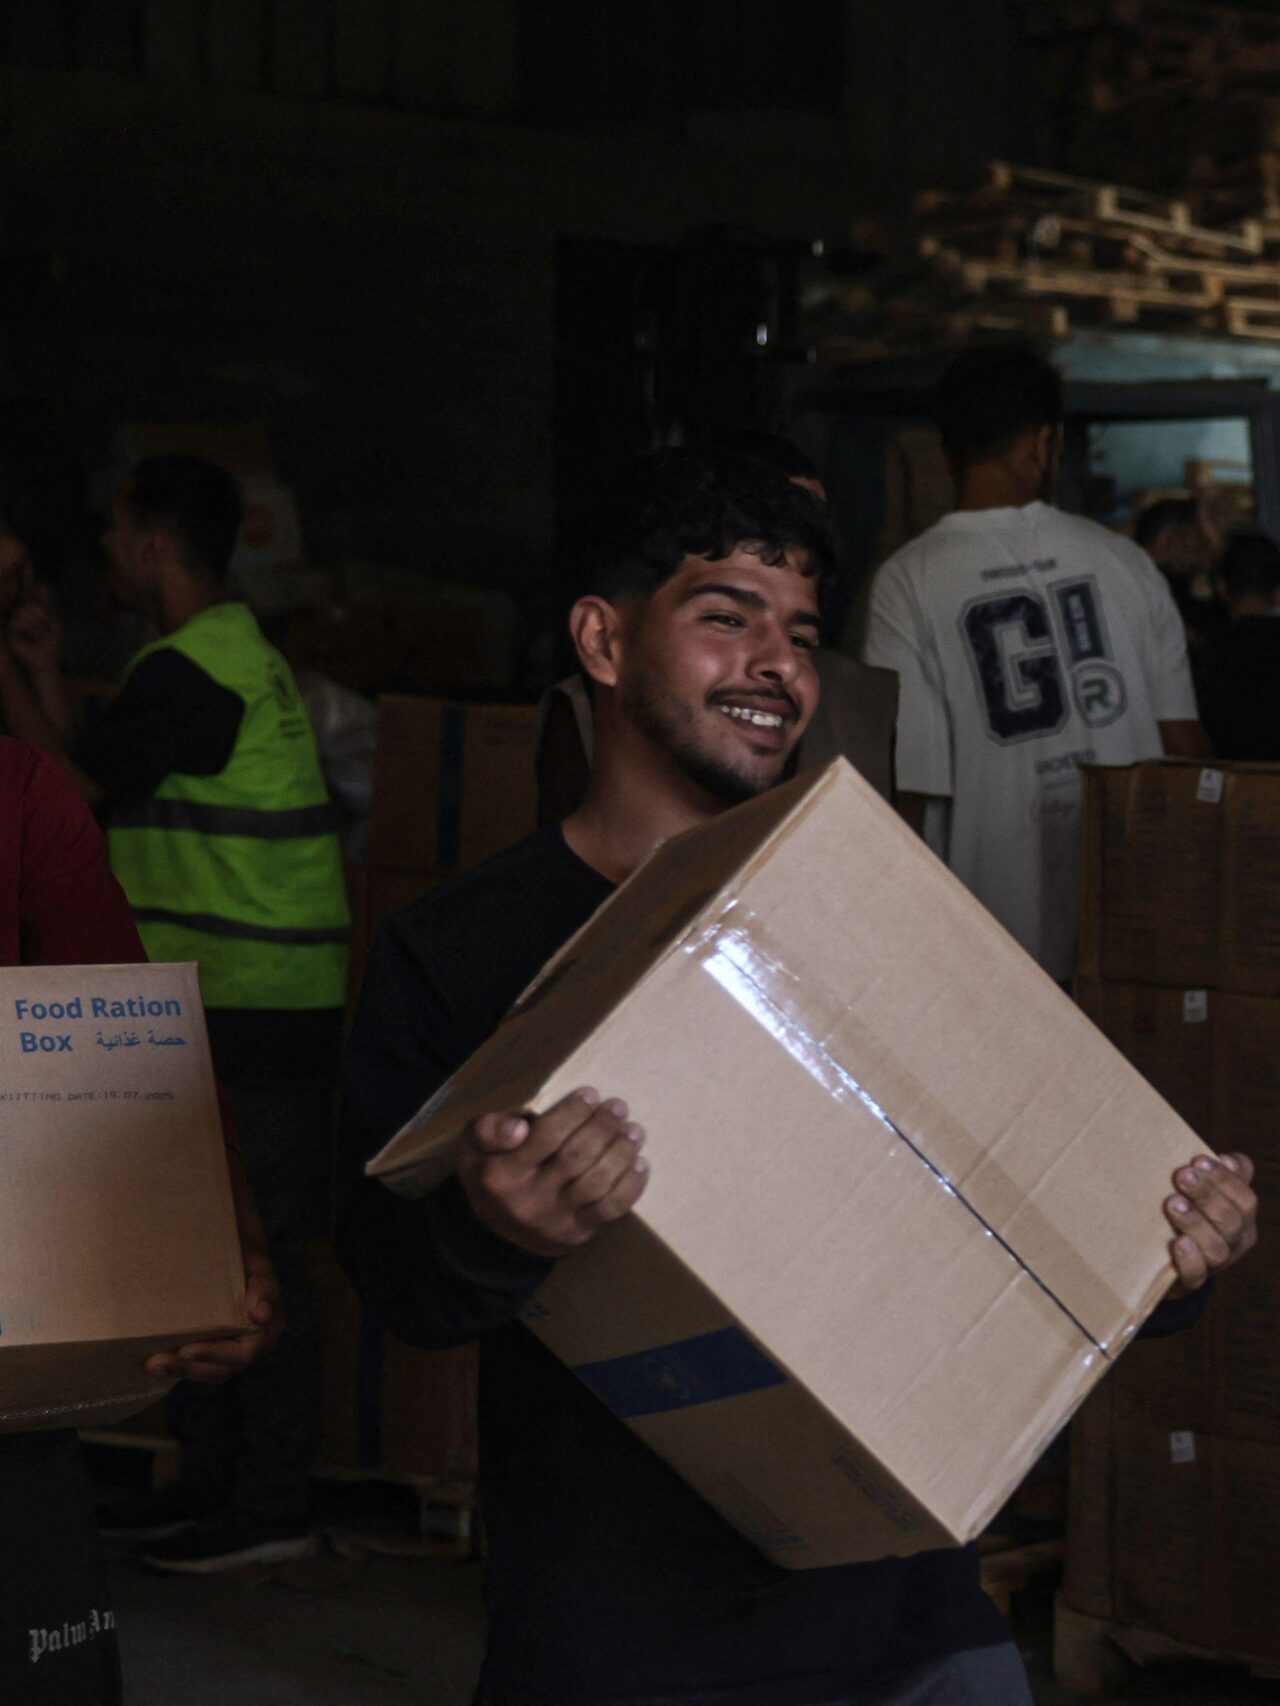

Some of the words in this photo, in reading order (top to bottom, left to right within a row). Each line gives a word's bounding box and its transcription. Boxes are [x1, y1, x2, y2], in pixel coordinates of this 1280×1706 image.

[15, 997, 83, 1020] Food
[91, 995, 182, 1018] Ration
[20, 1032, 73, 1053] Box
